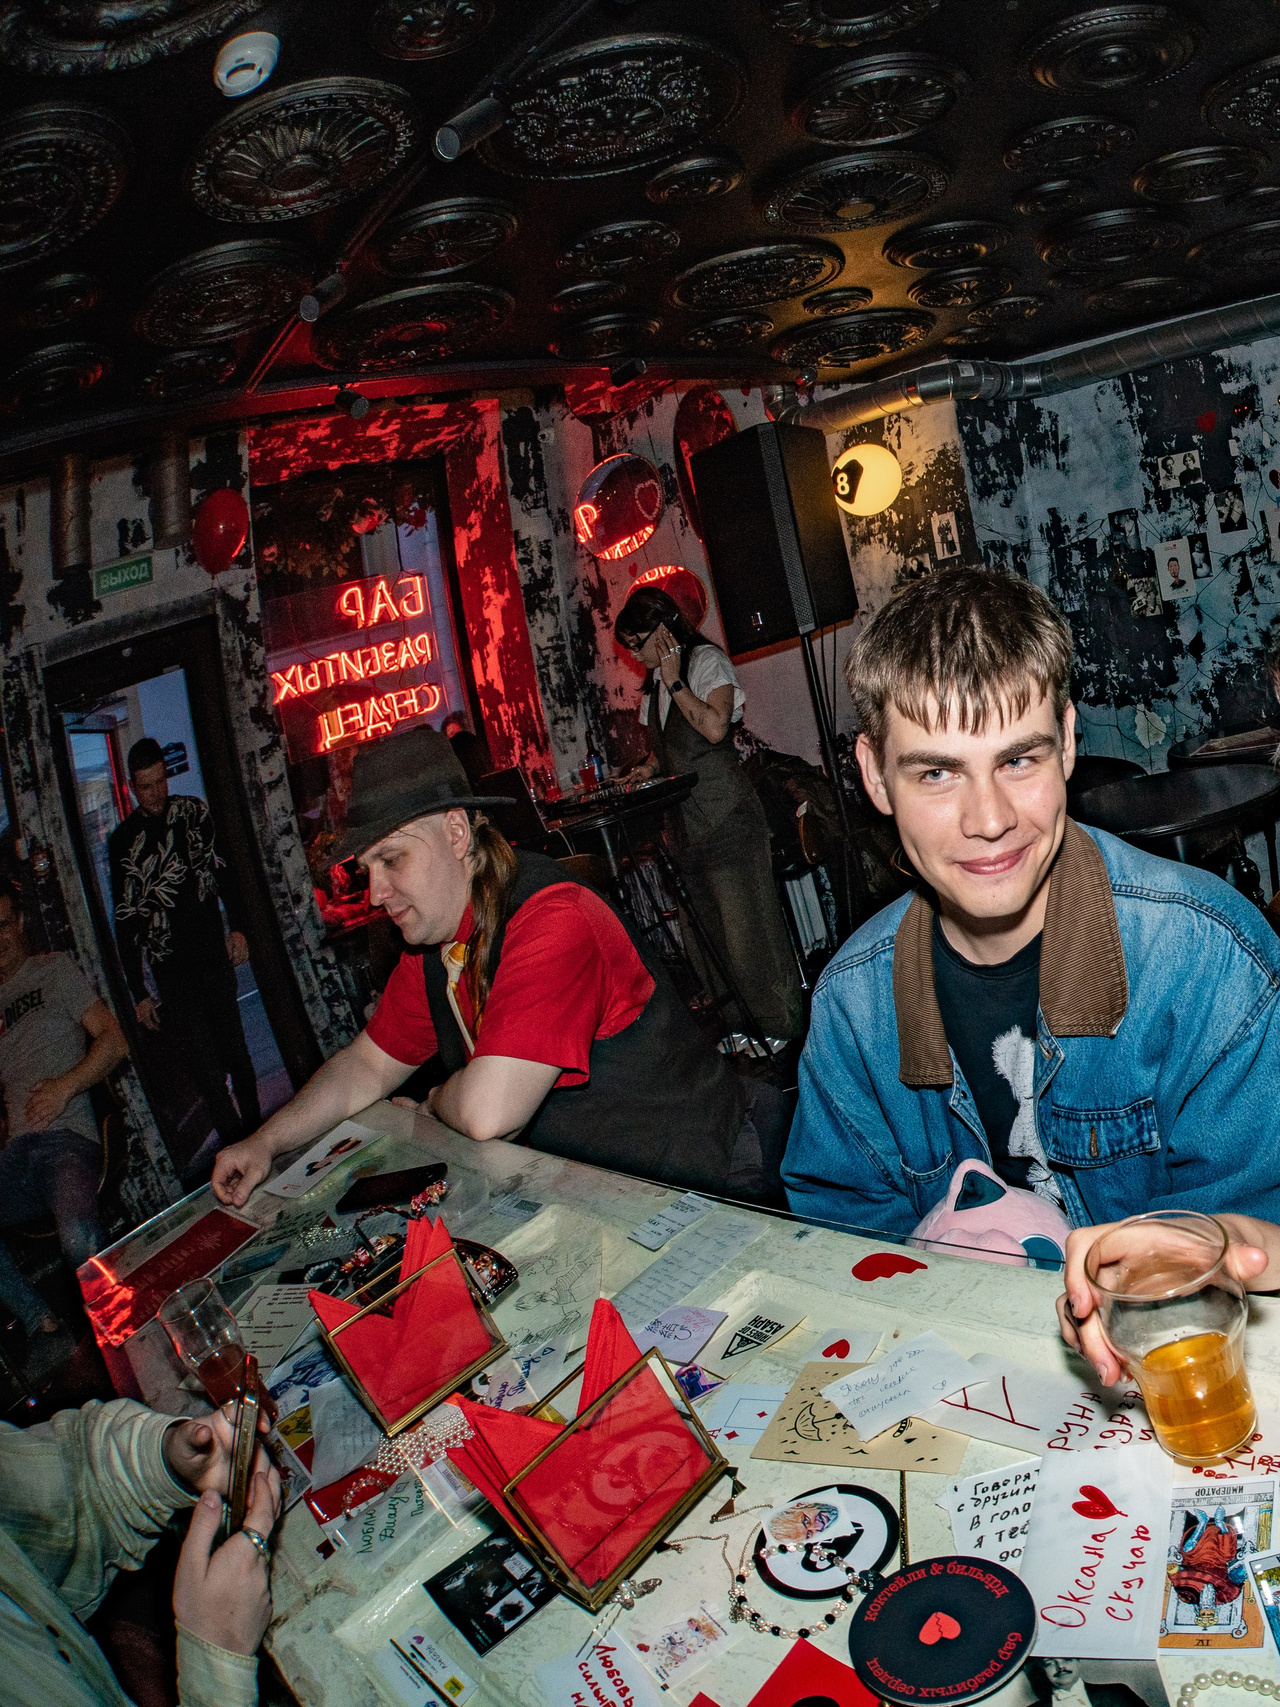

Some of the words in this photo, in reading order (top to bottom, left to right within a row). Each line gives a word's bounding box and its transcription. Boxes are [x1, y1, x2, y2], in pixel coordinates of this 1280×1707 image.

[836, 472, 850, 495] 8
[5, 988, 45, 1029] DIESEL
[738, 1326, 750, 1334] OF
[747, 1315, 785, 1336] ASAPH
[749, 1329, 773, 1344] TRIBES
[1194, 1485, 1244, 1497] ИМПЕРАТОР
[378, 1496, 410, 1542] Диану
[989, 1501, 1031, 1524] голо
[863, 1566, 928, 1622] коктейли
[930, 1562, 944, 1576] &
[946, 1560, 1010, 1599] бильярд
[1040, 1526, 1118, 1628] Оксана
[997, 1631, 1023, 1661] бар
[866, 1656, 916, 1696] сердец
[917, 1659, 1004, 1698] разбитых
